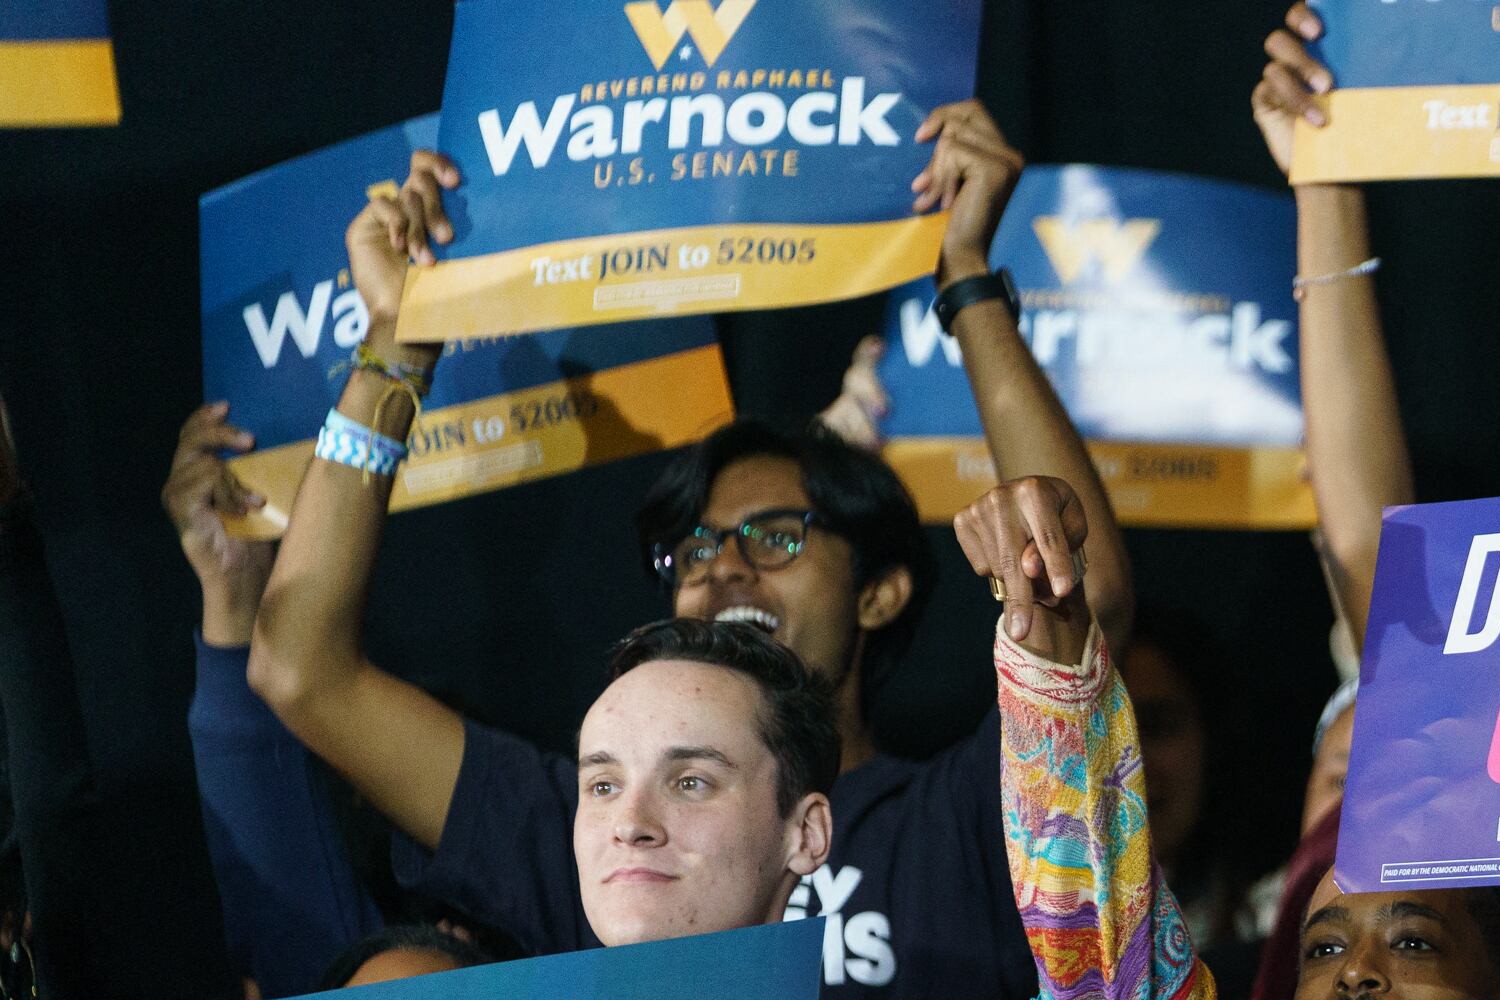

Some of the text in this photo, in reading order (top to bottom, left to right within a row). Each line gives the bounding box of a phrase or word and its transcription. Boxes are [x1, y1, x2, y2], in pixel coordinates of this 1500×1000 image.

[580, 69, 836, 104] REVEREND RAPHAEL
[477, 76, 902, 177] Warnock
[1423, 100, 1491, 129] Text
[594, 149, 801, 189] U.S. SENATE
[531, 238, 816, 287] Text JOIN to 52005
[408, 418, 466, 457] OIN
[472, 415, 505, 444] to
[1399, 868, 1411, 876] FOR
[1431, 865, 1468, 874] DEMOCRATIC
[1469, 864, 1497, 872] NATIONAL
